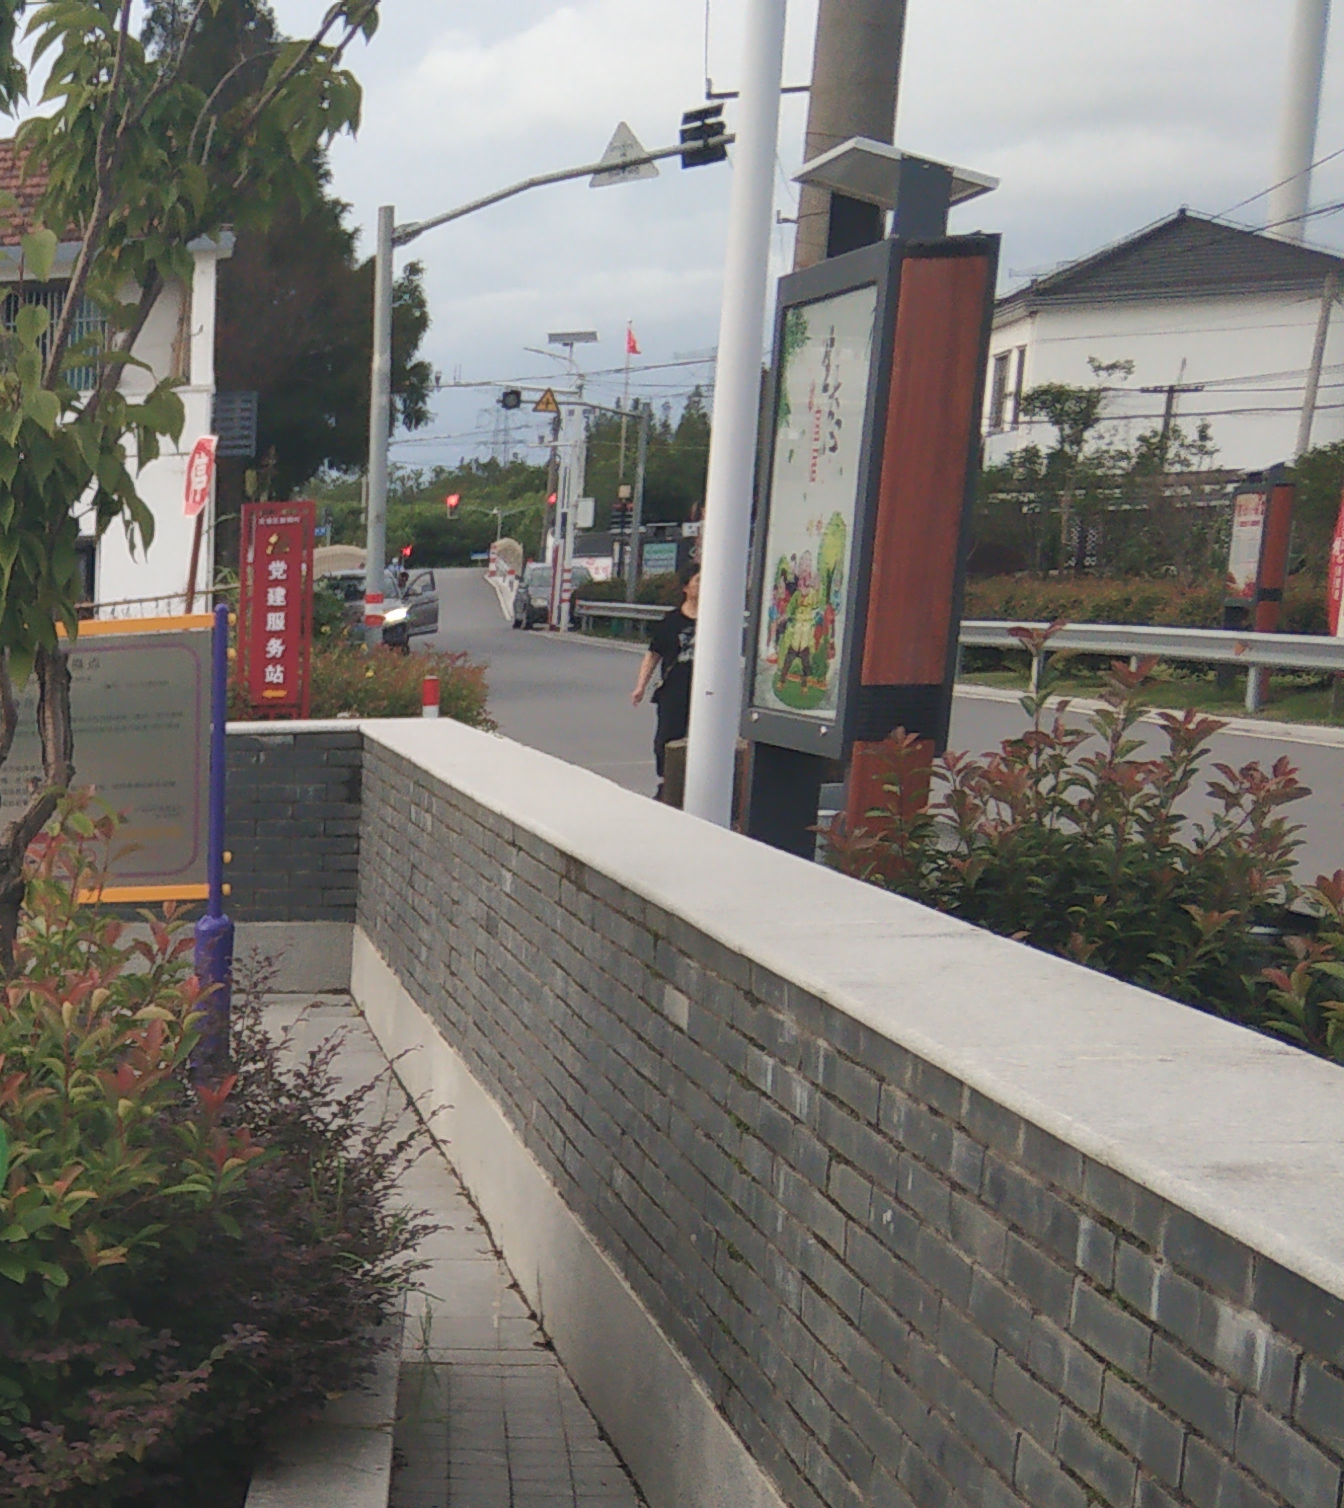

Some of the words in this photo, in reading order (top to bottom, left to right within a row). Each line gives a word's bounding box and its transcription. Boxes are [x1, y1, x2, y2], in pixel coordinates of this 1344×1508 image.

[264, 560, 288, 684] 党建服务站
